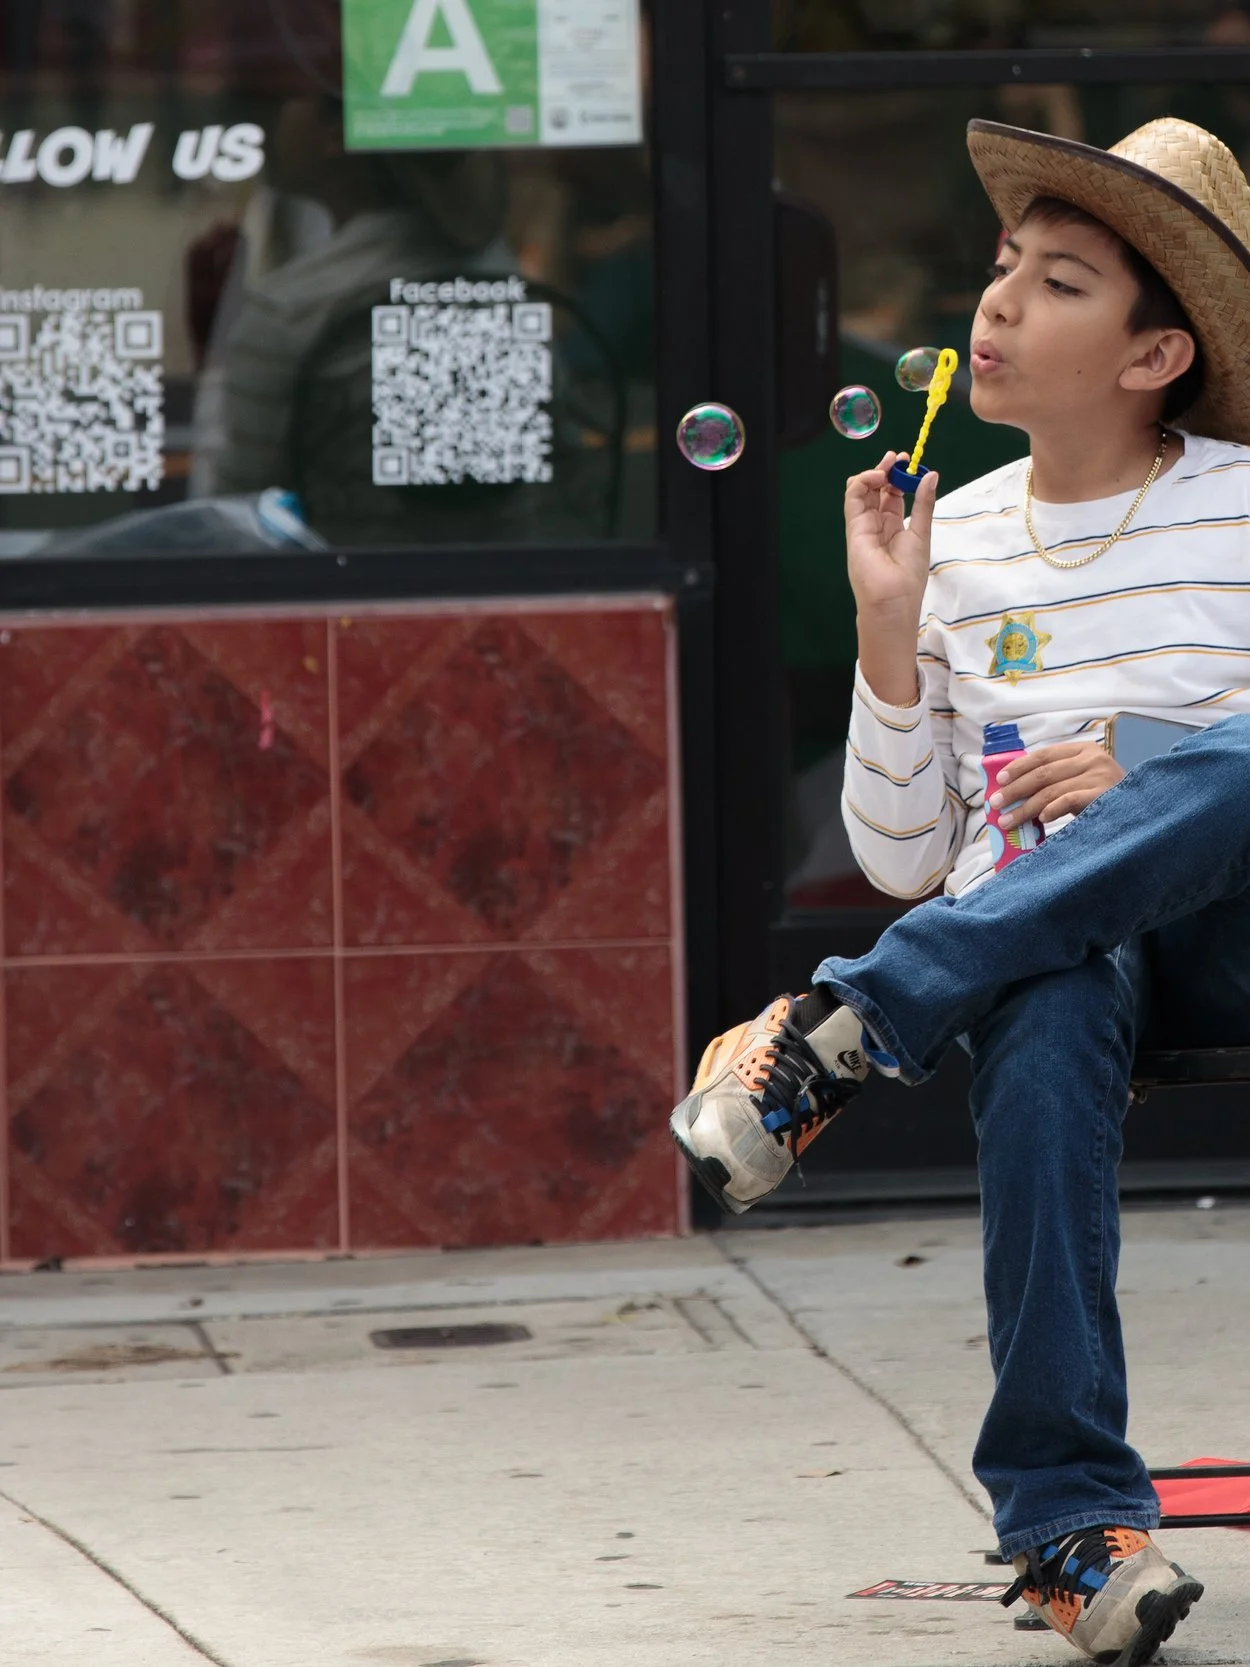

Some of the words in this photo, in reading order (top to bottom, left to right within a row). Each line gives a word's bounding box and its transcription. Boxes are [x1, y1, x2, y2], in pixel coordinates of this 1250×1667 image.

[380, 0, 503, 95] A
[0, 122, 154, 187] LOW
[172, 122, 265, 182] US
[0, 283, 144, 313] nstagram
[390, 275, 527, 303] Facebook
[847, 1049, 862, 1071] NIKE
